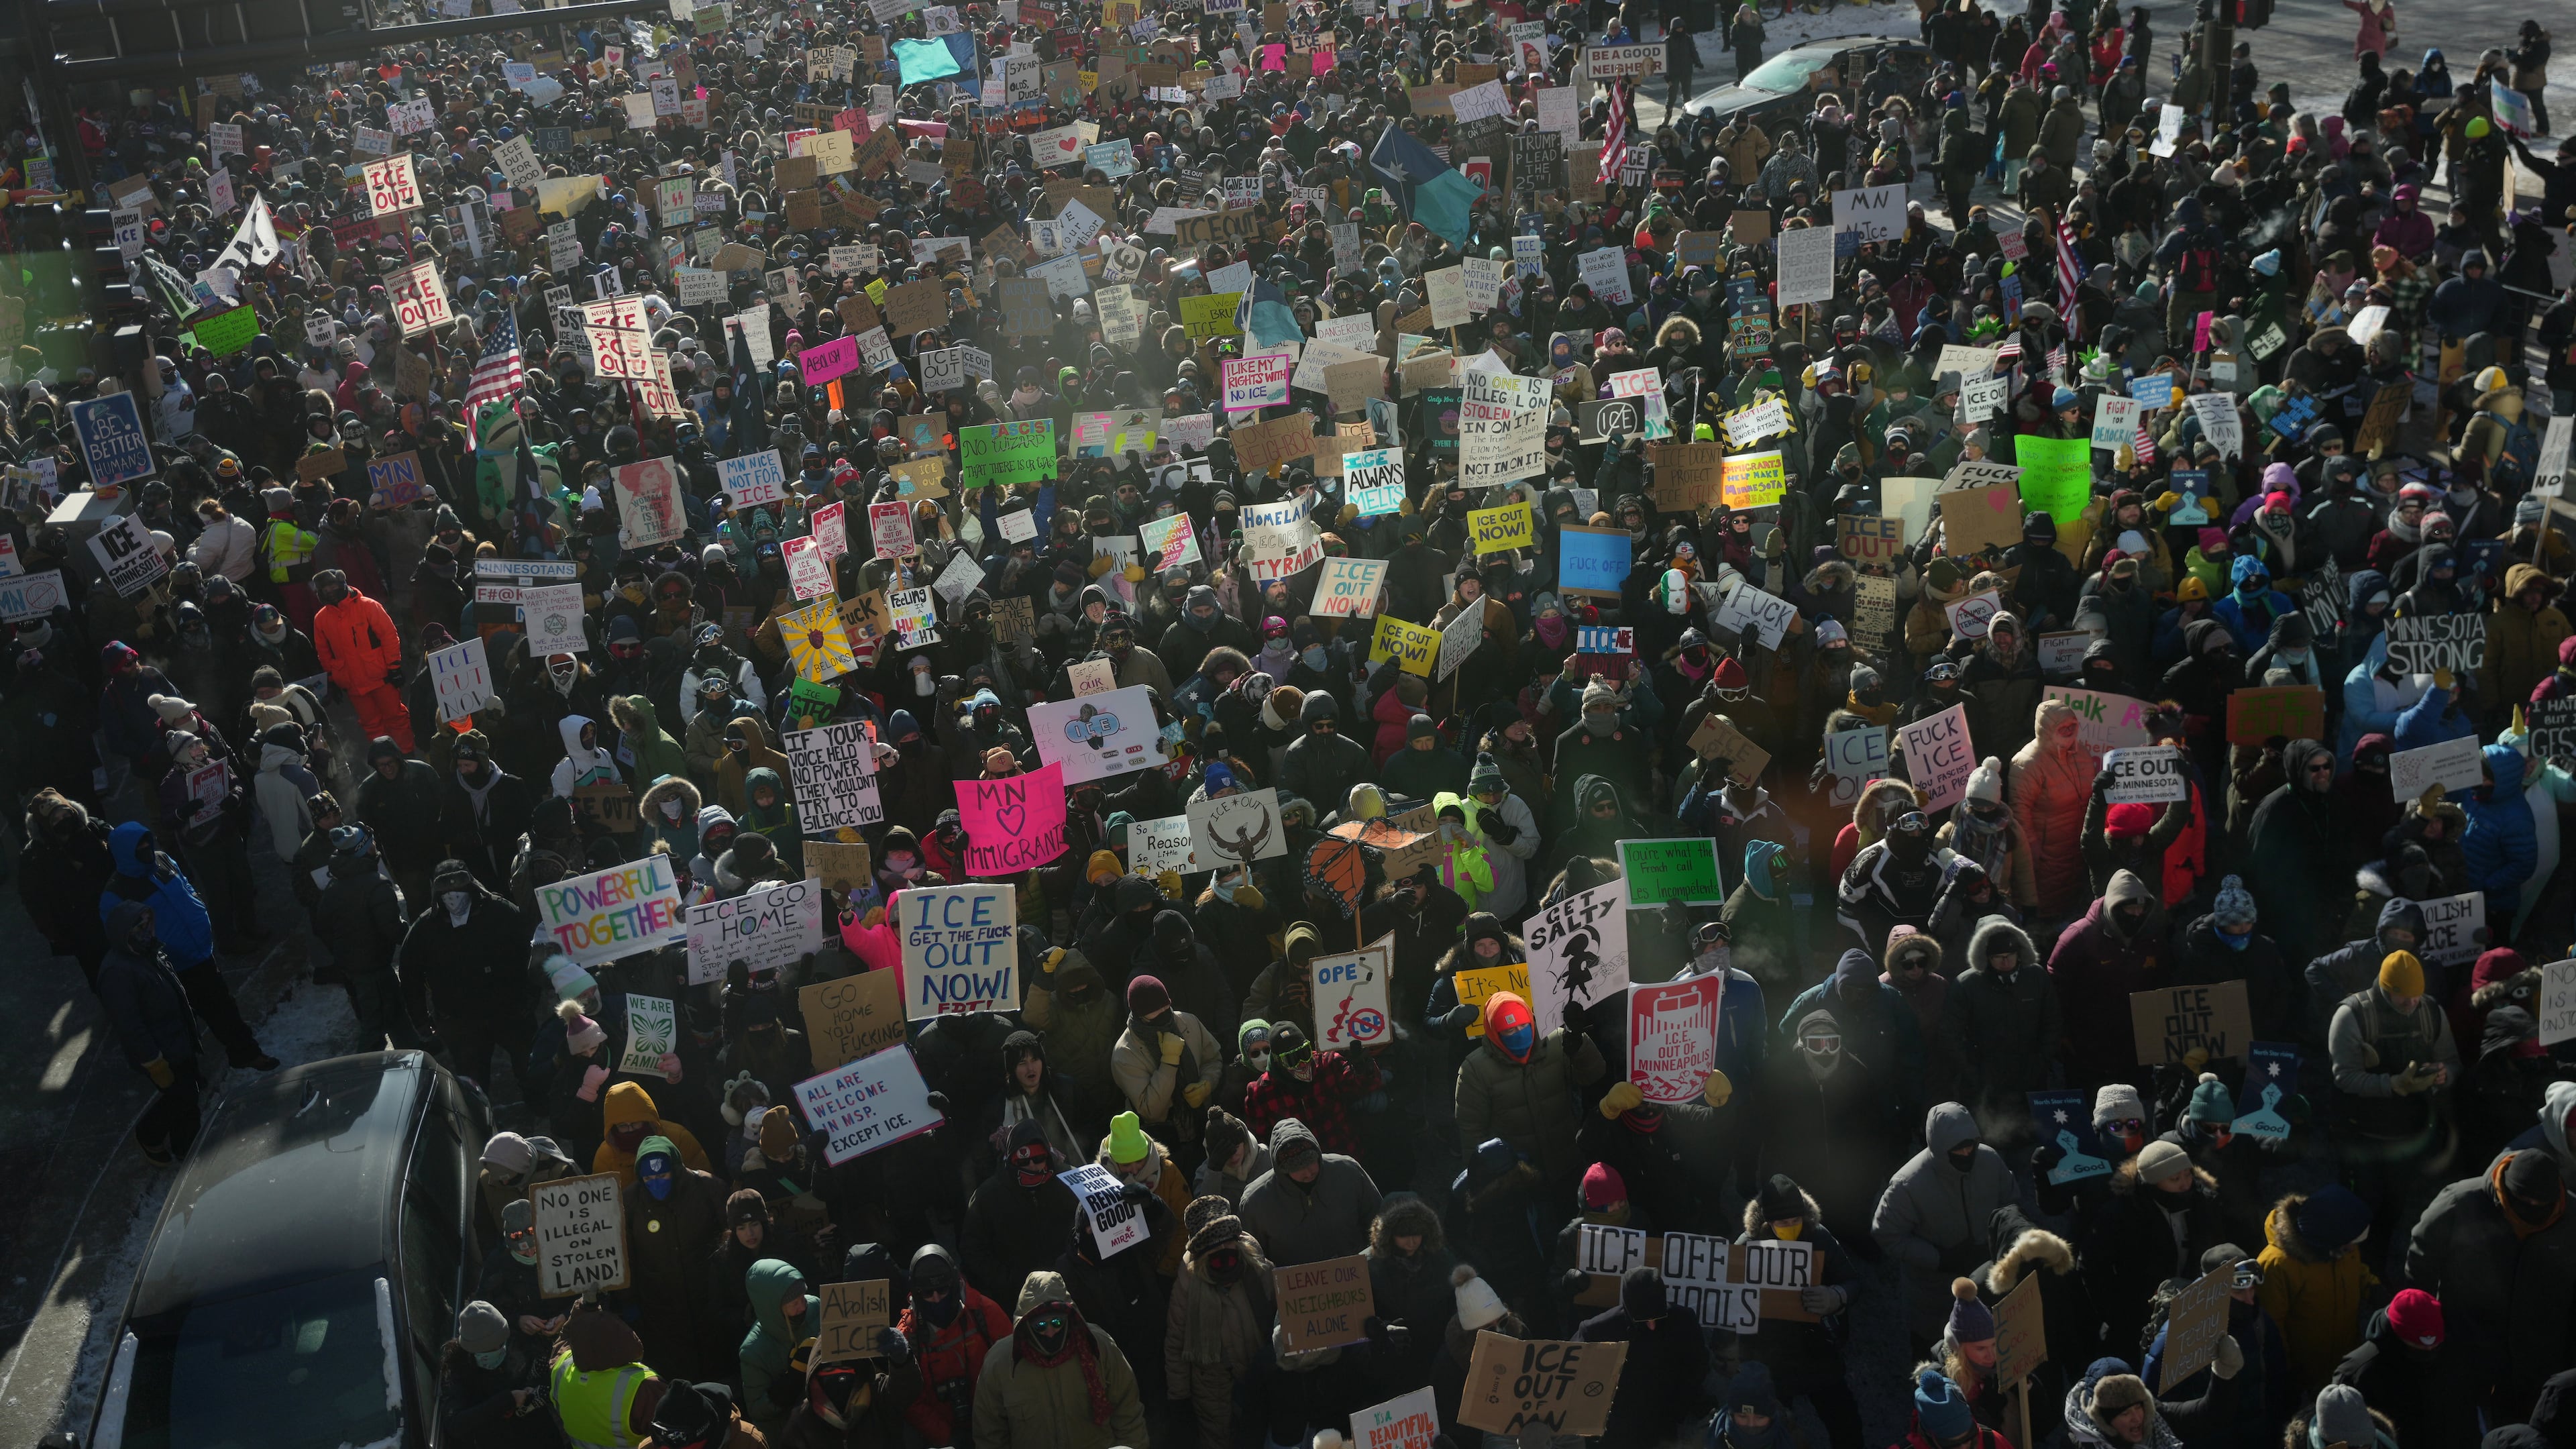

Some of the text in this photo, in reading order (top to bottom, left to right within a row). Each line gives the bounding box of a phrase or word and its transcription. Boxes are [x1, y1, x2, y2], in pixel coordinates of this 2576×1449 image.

[1593, 46, 1660, 61] BE A GOOD
[1209, 74, 1226, 86] ICE
[1019, 87, 1039, 100] DUDE
[1208, 84, 1236, 97] STINKS
[841, 111, 863, 127] ICE
[1479, 121, 1501, 135] PREVENT
[547, 130, 563, 140] ICE
[1032, 133, 1063, 145] GENOCIDE
[1517, 135, 1560, 150] TRUMP:
[359, 137, 390, 153] ICE
[500, 142, 523, 158] ICE
[547, 140, 565, 150] OUT
[506, 153, 525, 167] OUT
[1041, 153, 1057, 161] LOVE
[1515, 151, 1557, 165] PLEAD
[368, 164, 397, 173] NEIGHBORS
[372, 165, 409, 189] ICE
[1525, 164, 1548, 174] THE
[1226, 178, 1258, 191] GIVE US
[1292, 189, 1325, 199] DE-ICE
[1851, 191, 1889, 209] MN
[114, 213, 139, 225] ABOLISH
[117, 229, 137, 242] ICE
[1999, 234, 2023, 248] FASCISM
[1470, 260, 1491, 270] EVEN
[392, 279, 436, 306] ICE
[683, 290, 718, 298] TERRORIST
[401, 298, 443, 326] OUT!
[591, 306, 637, 317] NEIGHBORS SAY
[1228, 370, 1287, 388] RIGHTS WITH
[1467, 374, 1542, 394] NO ONE IS
[1615, 371, 1658, 396] ICE
[647, 388, 676, 411] OUT!
[1230, 386, 1267, 400] NO ICE
[1966, 385, 2006, 405] ICE OUT
[1463, 402, 1511, 419] STOLEN
[1732, 403, 1772, 423] CAUTION
[1969, 405, 1978, 414] OF
[95, 417, 119, 439] BE
[991, 421, 1051, 437] FASCIST
[1732, 409, 1780, 433] CIVIL RIGHTS
[2094, 426, 2136, 444] DEMOCRACY
[90, 433, 144, 461] BETTER
[94, 453, 146, 478] HUMANS
[728, 453, 775, 472] MN NICE
[1344, 451, 1388, 466] ICE
[370, 458, 415, 488] MN
[729, 467, 780, 490] NOT FOR
[1477, 509, 1523, 526] ICE OUT
[1845, 517, 1895, 537] ICE
[883, 531, 894, 539] OUT
[1146, 519, 1187, 537] ALL ARE
[1148, 529, 1189, 546] WELCOME
[1479, 523, 1526, 540] NOW!
[878, 535, 910, 545] MINNEAPOLIS
[1844, 536, 1898, 557] OUT
[476, 562, 575, 576] MINNESOTANS
[1569, 557, 1625, 572] FUCK OFF
[1335, 581, 1366, 596] OUT
[2302, 584, 2322, 600] NO
[993, 596, 1031, 612] SAVE
[1324, 596, 1371, 616] NOW!
[1733, 583, 1792, 627] FUCK
[2383, 616, 2484, 643] MINNESOTA
[1578, 627, 1633, 652] ICE ARE
[2043, 637, 2072, 647] FIGHT
[435, 647, 477, 673] ICE
[814, 653, 851, 674] BELONGS
[440, 667, 483, 696] OUT
[1080, 678, 1104, 692] OUR
[803, 688, 820, 700] ICE
[1075, 717, 1112, 737] ICE
[1909, 716, 1958, 757] FUCK
[786, 722, 866, 752] IF YOUR
[790, 743, 858, 765] VOICE HELD
[1827, 735, 1884, 769] ICE
[1923, 741, 1966, 775] ICE
[977, 782, 1025, 810] MN
[1135, 819, 1187, 835] So Many
[1626, 843, 1713, 863] You're what the
[1640, 859, 1692, 873] French call
[544, 859, 671, 923] POWERFUL
[914, 895, 996, 929] ICE
[1546, 890, 1595, 924] GET
[554, 898, 678, 955] TOGETHER
[723, 904, 797, 941] HOME
[1530, 896, 1618, 951] SALTY
[910, 926, 1013, 947] GET THE FUCK
[1318, 963, 1358, 985] OPE
[2171, 989, 2211, 1012] ICE
[833, 1005, 873, 1025] HOME
[2166, 1013, 2212, 1036] OUT
[1347, 1014, 1385, 1037] ICE
[841, 1020, 904, 1053] FUCKING
[1665, 1029, 1690, 1044] I.C.E.
[1658, 1040, 1697, 1059] OUT OF
[807, 1072, 863, 1102] ALL ARE
[2033, 1097, 2050, 1106] North
[2065, 1097, 2080, 1106] rising
[1063, 1165, 1106, 1185] JUSTICIA
[2074, 1162, 2106, 1173] Good
[1085, 1176, 1112, 1189] PARA
[541, 1187, 612, 1210] NO ONE
[569, 1237, 592, 1249] ON
[1586, 1226, 1809, 1287] ICE OFF OUR
[1287, 1267, 1360, 1290] LEAVE OUR
[823, 1289, 886, 1318] Abolish
[1285, 1289, 1366, 1316] NEIGHBORS
[1306, 1316, 1349, 1336] ALONE
[1522, 1344, 1583, 1374] ICE
[1513, 1375, 1574, 1401] OUT
[1368, 1411, 1434, 1444] BEAUTIFUL
